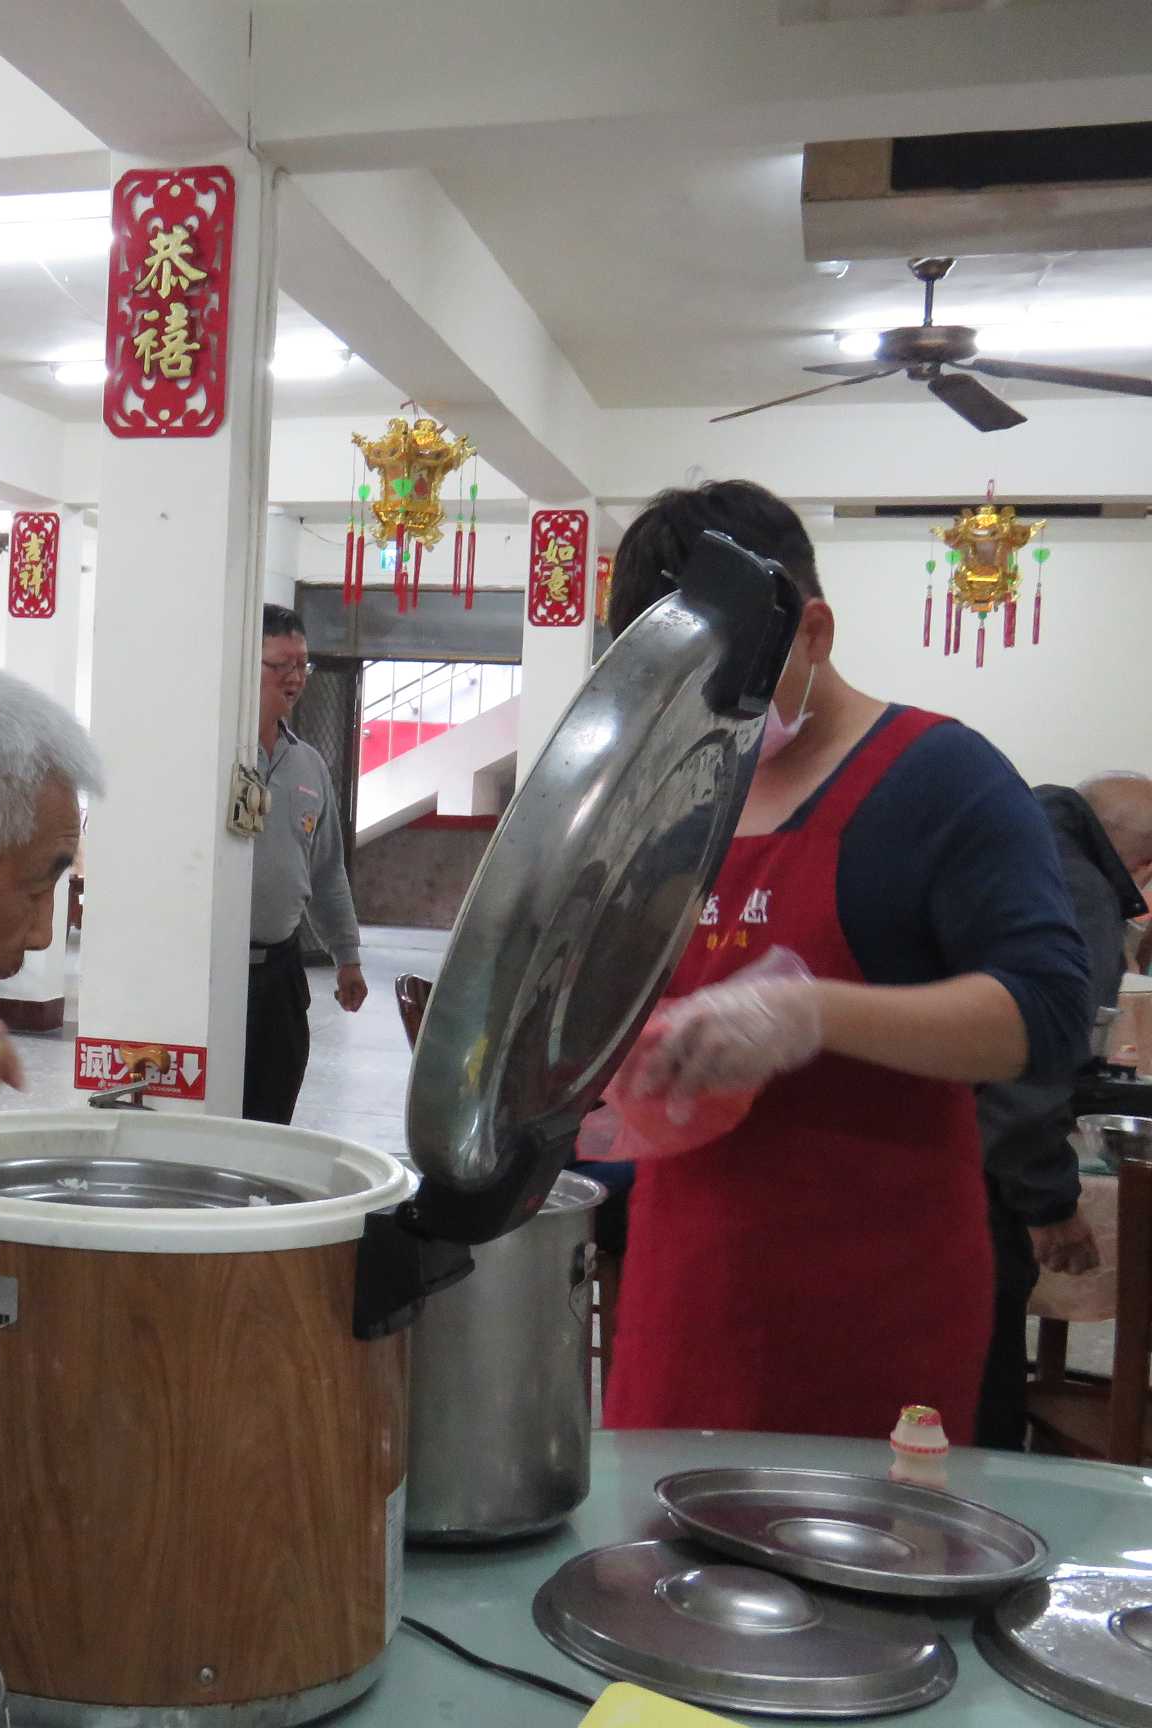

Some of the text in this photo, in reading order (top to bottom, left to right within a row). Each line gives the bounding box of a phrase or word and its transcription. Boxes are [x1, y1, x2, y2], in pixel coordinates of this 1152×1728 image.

[133, 224, 208, 379] 恭禧
[19, 532, 45, 598] 吉祥
[541, 537, 575, 602] 如意
